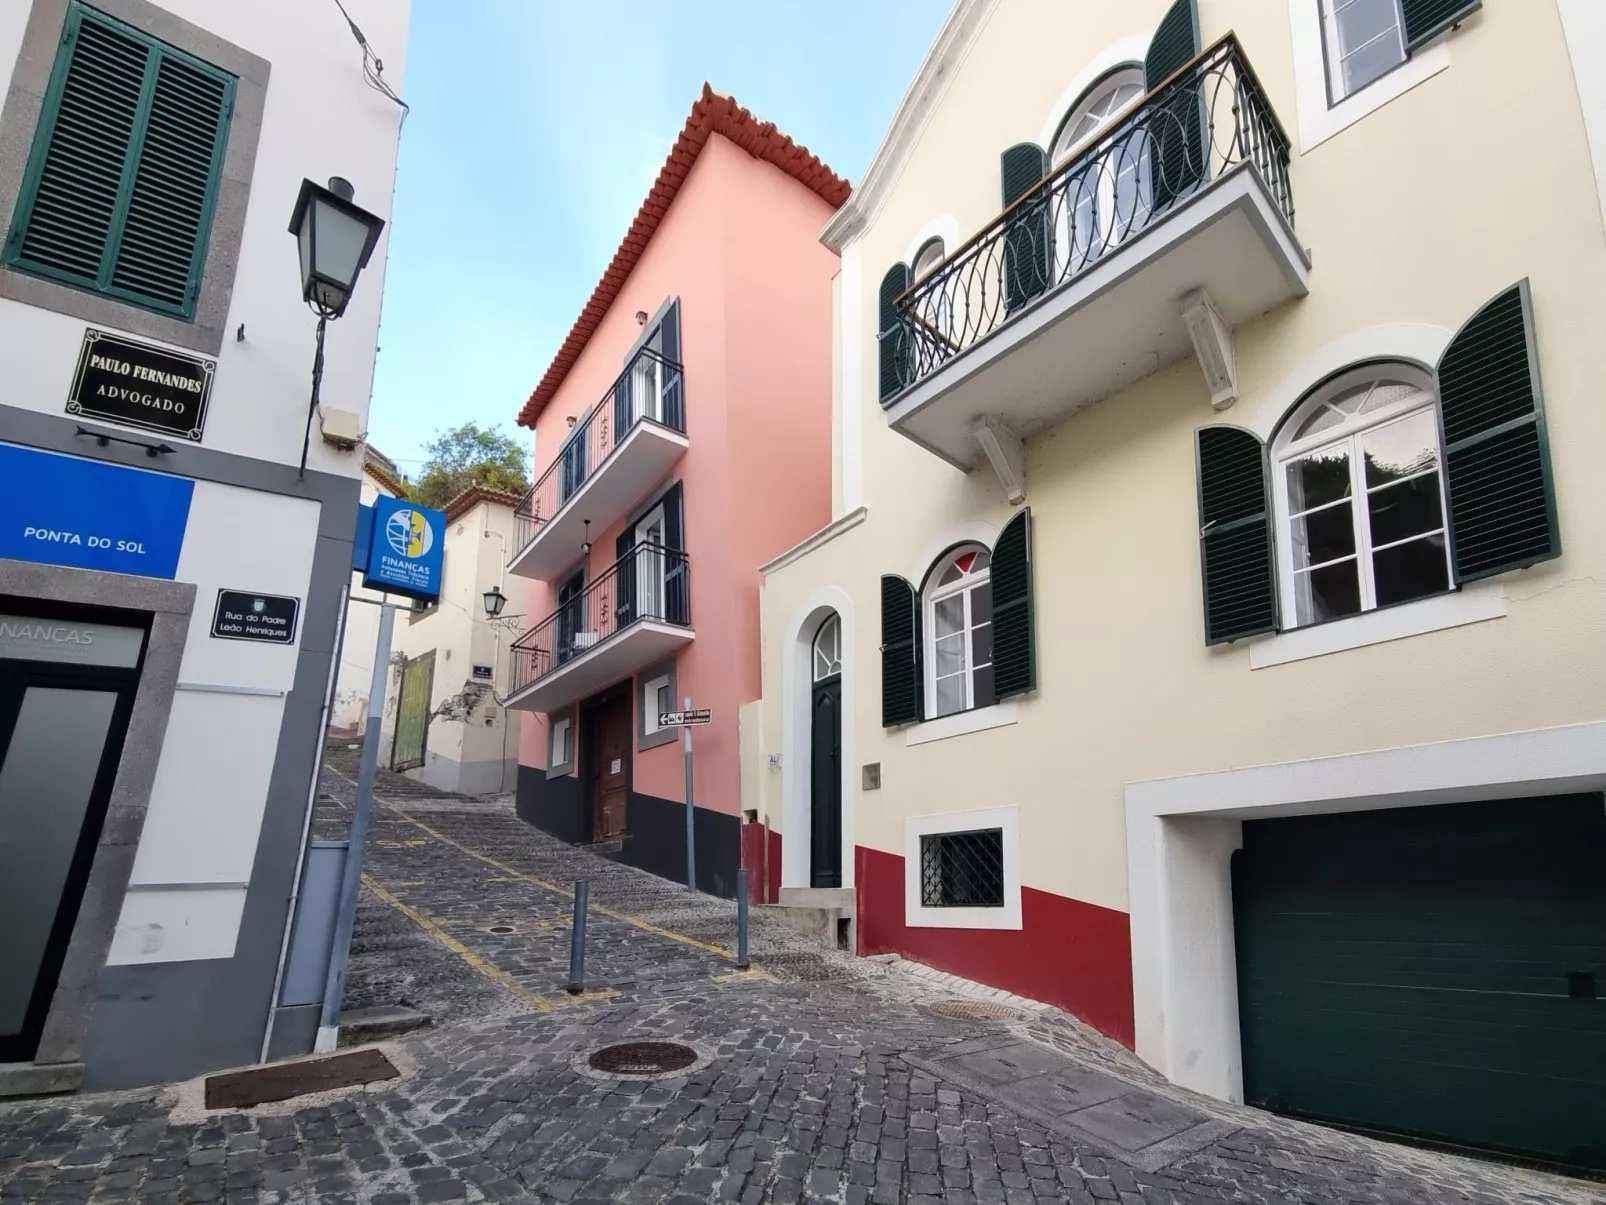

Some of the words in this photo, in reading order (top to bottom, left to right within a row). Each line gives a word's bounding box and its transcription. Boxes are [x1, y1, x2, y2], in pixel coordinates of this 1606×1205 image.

[90, 354, 130, 375] PAULO
[132, 365, 202, 393] FERNANDES
[97, 384, 185, 414] ADVOGADO
[24, 527, 81, 545] PONTA
[87, 536, 111, 549] DO
[116, 540, 146, 554] SOL
[382, 556, 430, 576] FINANÇAS
[225, 611, 243, 620] Rua
[246, 614, 258, 622] do
[262, 615, 286, 625] Padre
[220, 623, 242, 632] Leão
[245, 626, 287, 637] Henriques
